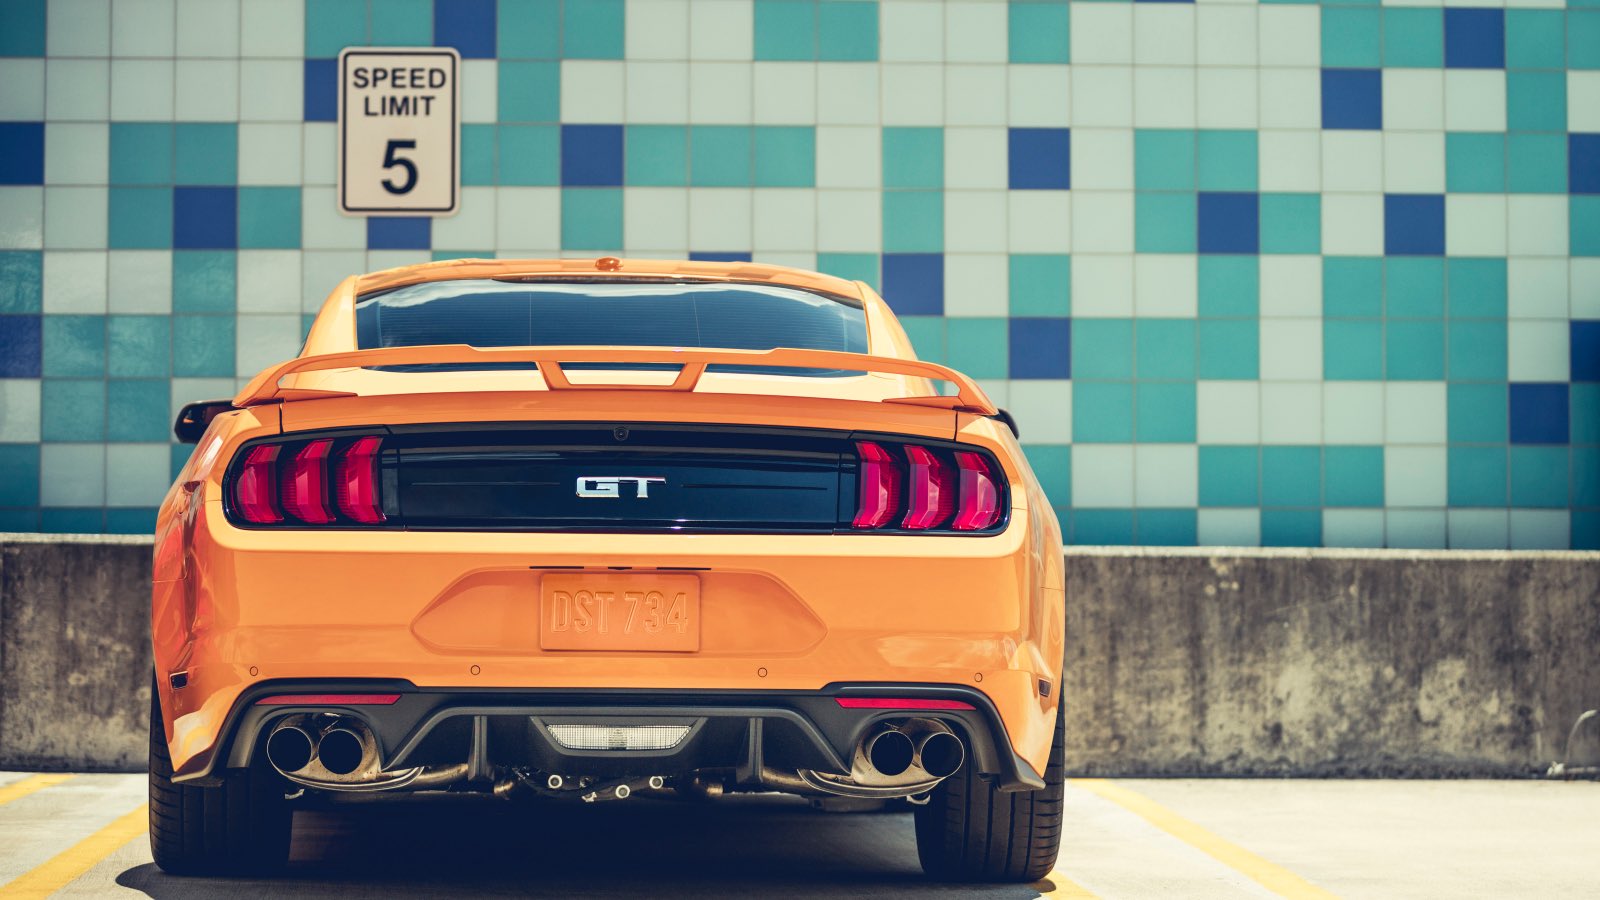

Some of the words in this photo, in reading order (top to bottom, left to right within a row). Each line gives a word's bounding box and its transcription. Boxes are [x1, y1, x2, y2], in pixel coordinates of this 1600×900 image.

[353, 68, 446, 89] SPEED
[364, 96, 436, 116] LIMIT
[381, 139, 419, 195] 5
[576, 476, 666, 498] GT
[551, 590, 615, 633] DST
[624, 590, 688, 634] 734
